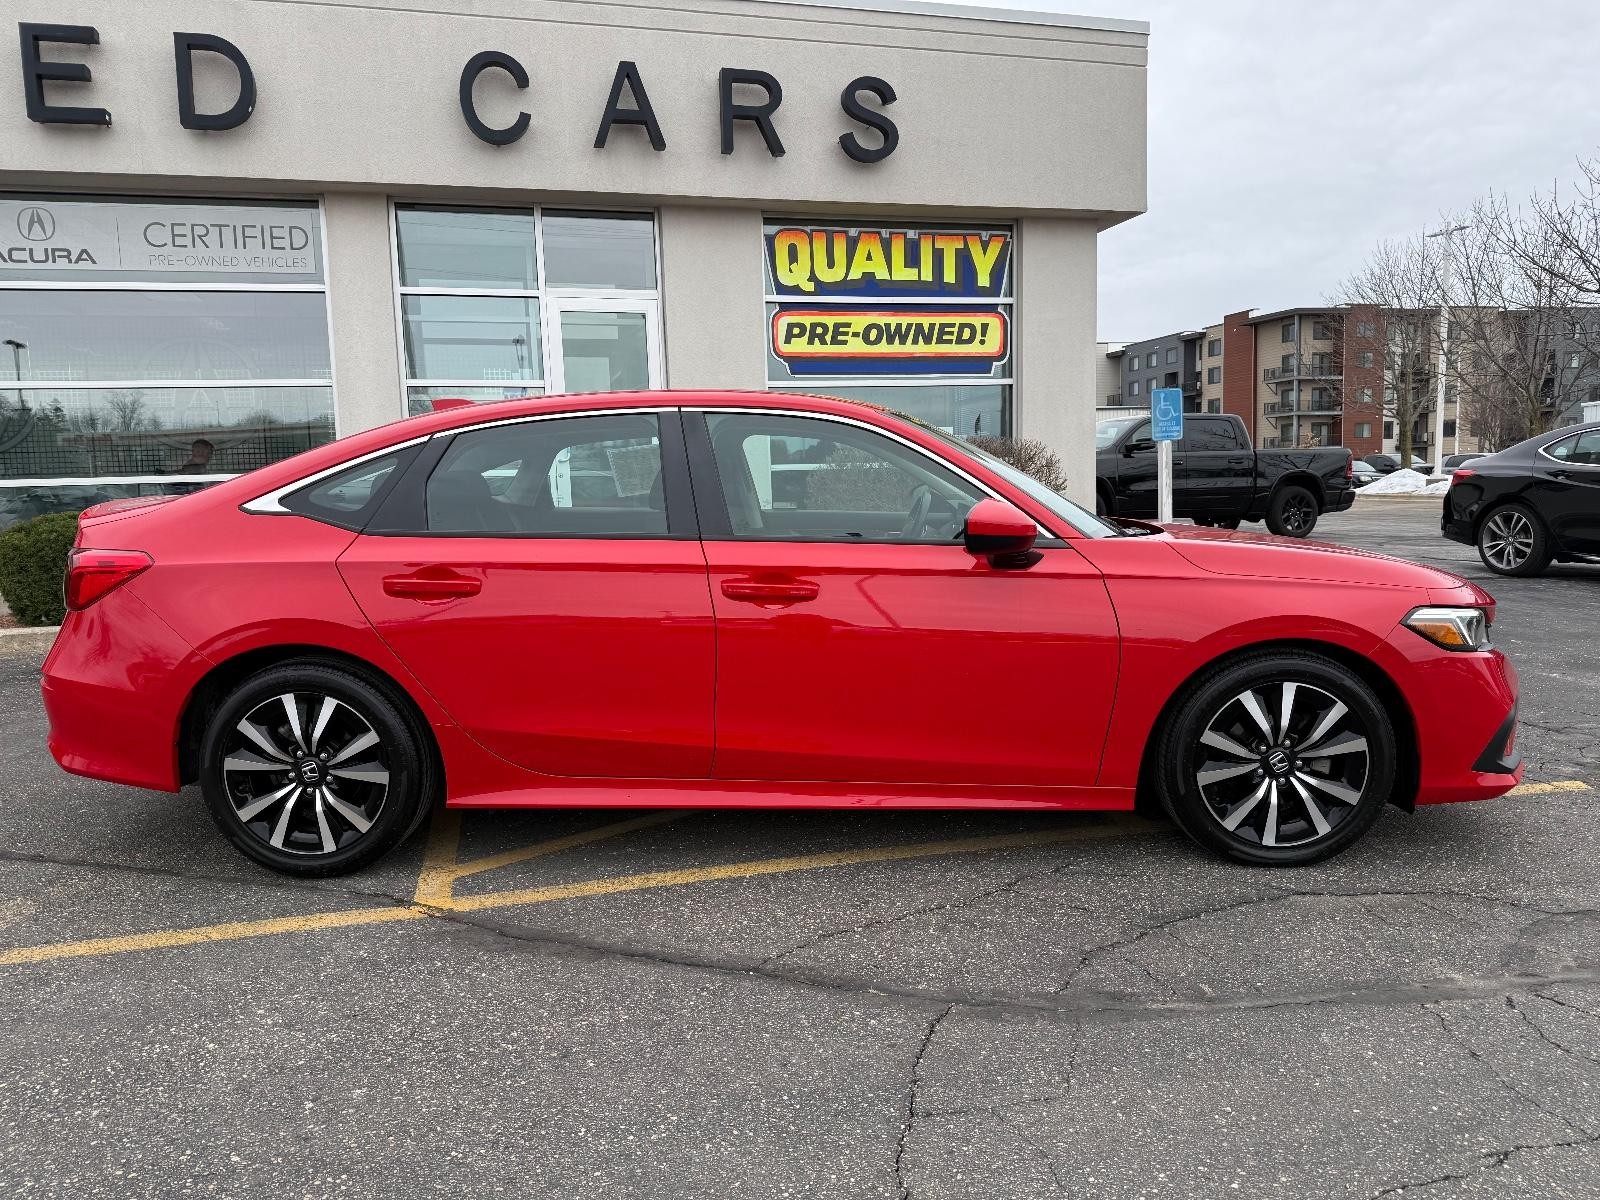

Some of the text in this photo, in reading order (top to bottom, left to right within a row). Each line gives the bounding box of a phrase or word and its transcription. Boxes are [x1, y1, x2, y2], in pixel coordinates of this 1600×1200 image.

[19, 22, 900, 163] ED CARS
[143, 221, 309, 250] CERTIFIED
[149, 254, 308, 268] PRE-OWNED VEHICLES
[774, 229, 1005, 292] QUALITY
[784, 321, 990, 346] PRE-OWNED!
